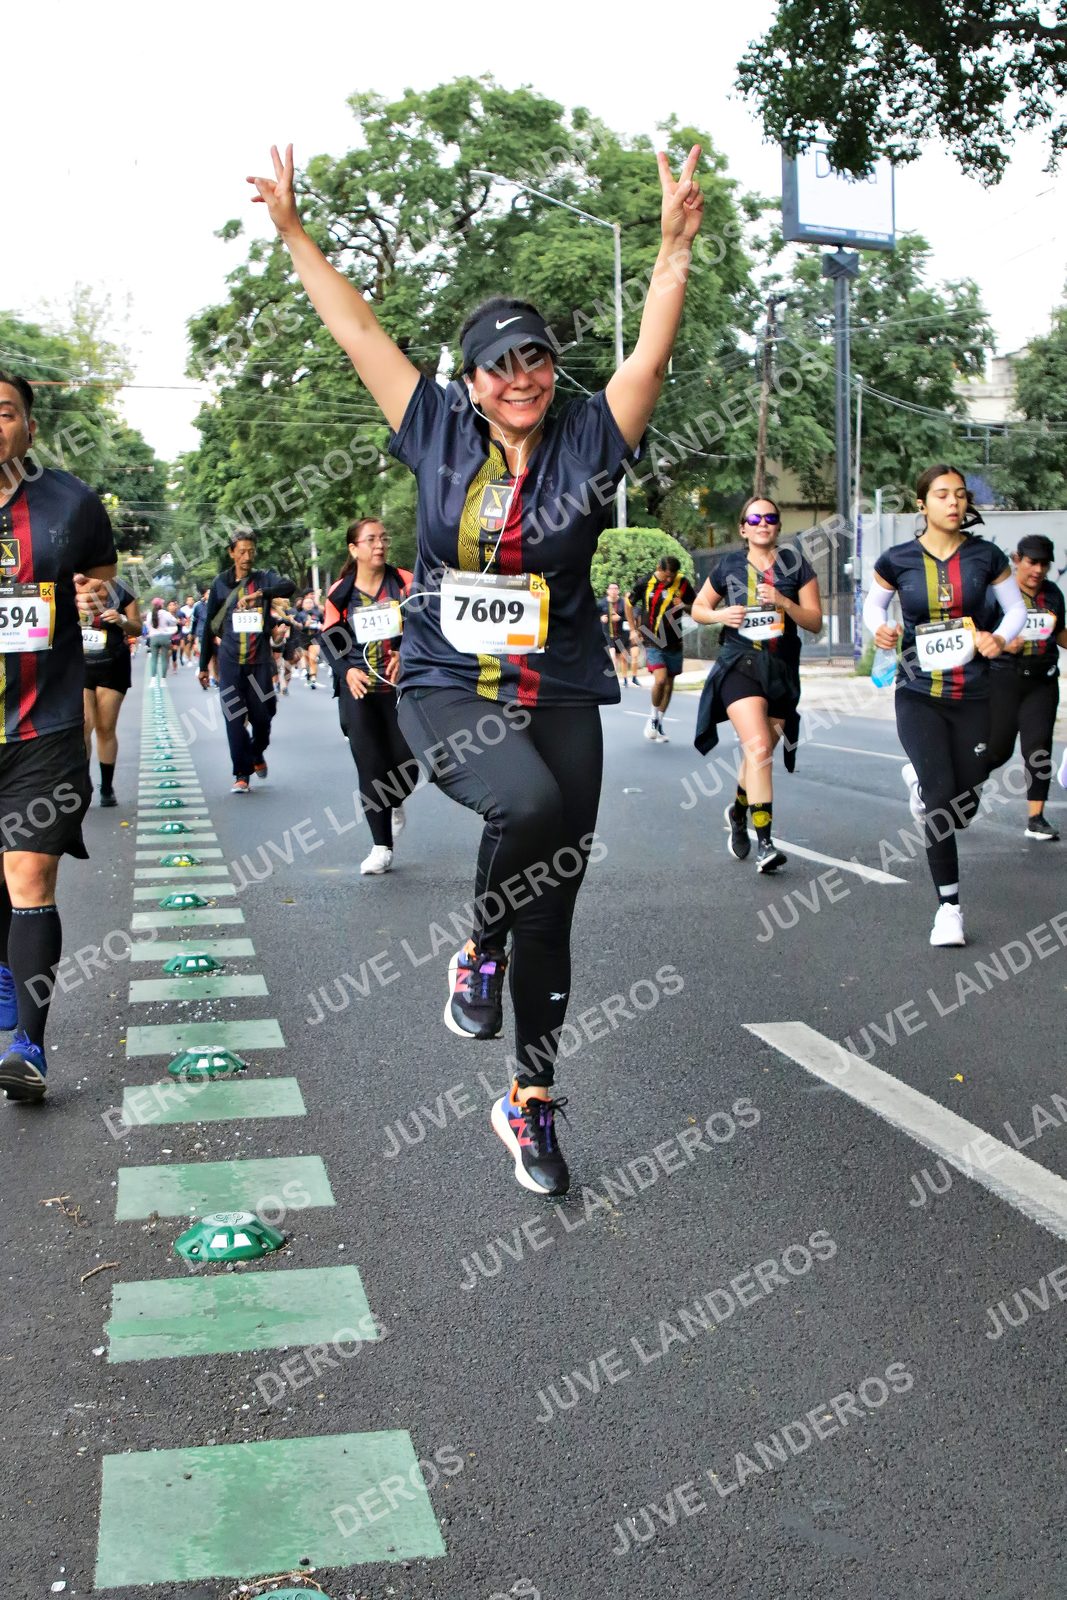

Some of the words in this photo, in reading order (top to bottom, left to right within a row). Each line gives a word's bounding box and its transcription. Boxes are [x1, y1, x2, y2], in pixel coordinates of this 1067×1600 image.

[454, 595, 525, 624] 7609
[744, 615, 775, 629] 2859
[1026, 617, 1046, 629] 214
[925, 634, 965, 656] 6645
